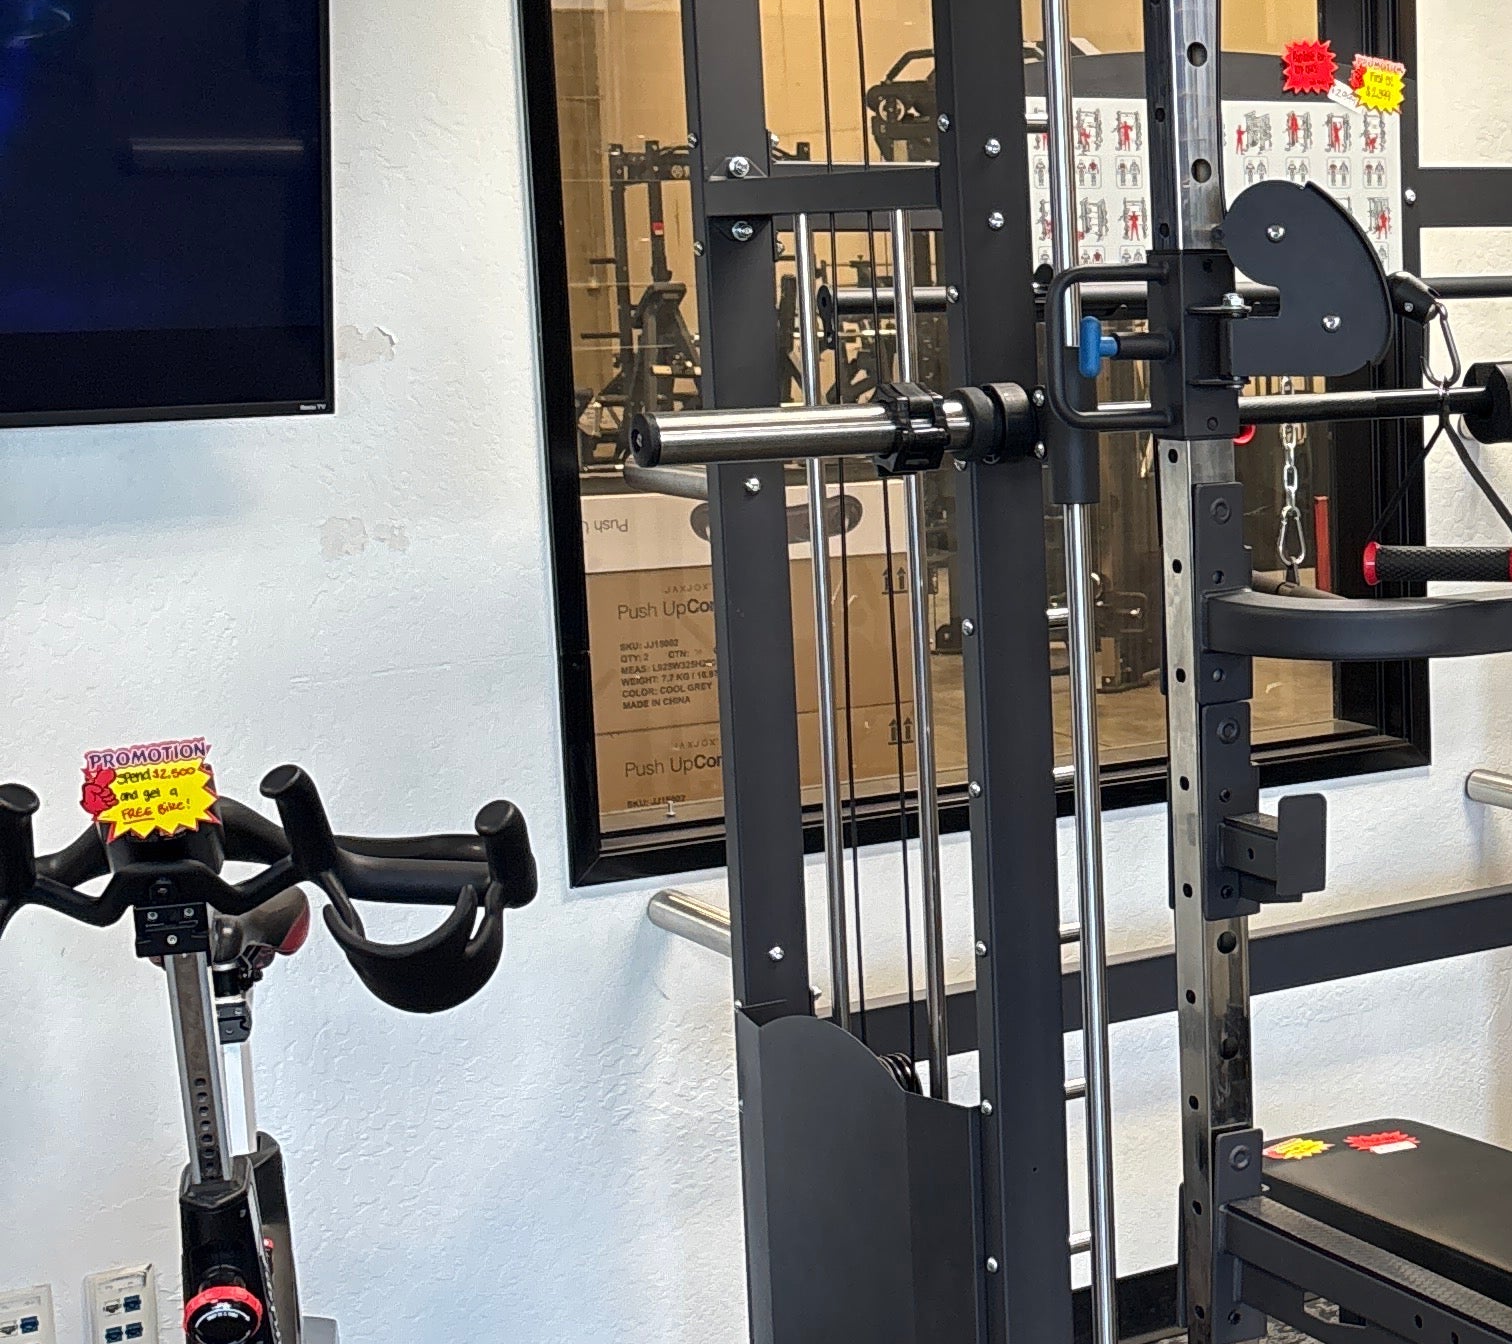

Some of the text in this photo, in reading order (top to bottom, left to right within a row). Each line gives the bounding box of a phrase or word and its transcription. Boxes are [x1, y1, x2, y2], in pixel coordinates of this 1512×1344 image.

[594, 518, 628, 533] Push
[617, 602, 658, 620] Push
[676, 672, 690, 681] KG
[622, 681, 713, 698] COLOR: COOL GREY
[622, 700, 649, 709] MADE
[663, 696, 691, 705] CHINA
[88, 741, 206, 769] PROMOTION
[624, 759, 665, 778] Push
[120, 787, 178, 802] and get a
[121, 807, 153, 820] FREE
